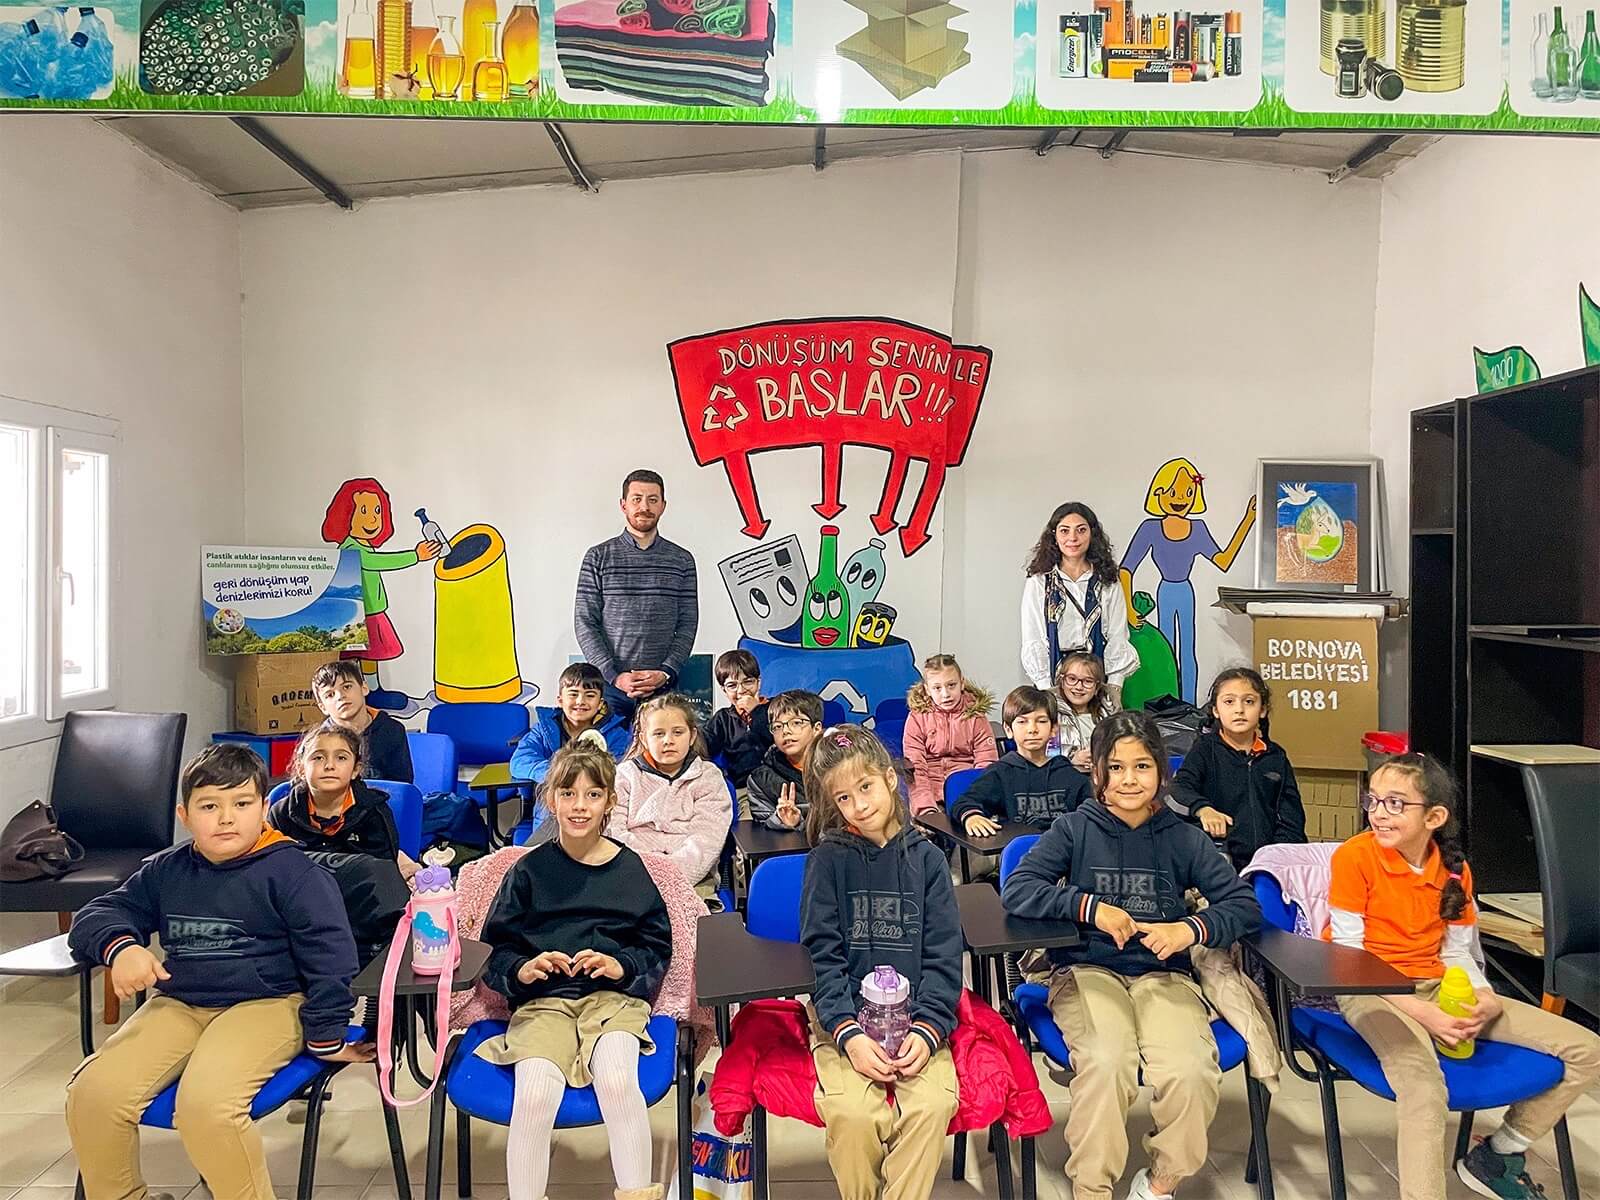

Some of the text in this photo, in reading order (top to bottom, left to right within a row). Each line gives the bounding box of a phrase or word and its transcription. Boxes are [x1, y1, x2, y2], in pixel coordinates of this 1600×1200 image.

[718, 334, 853, 375] DÖNÜŞÜM
[206, 552, 233, 560] Plastik
[307, 554, 327, 562] deniz
[239, 575, 288, 589] dönüşüm
[289, 575, 310, 587] yap
[1268, 639, 1363, 660] BORNOVA
[1260, 660, 1369, 683] BELEDİYESİ
[1288, 689, 1338, 710] 1881
